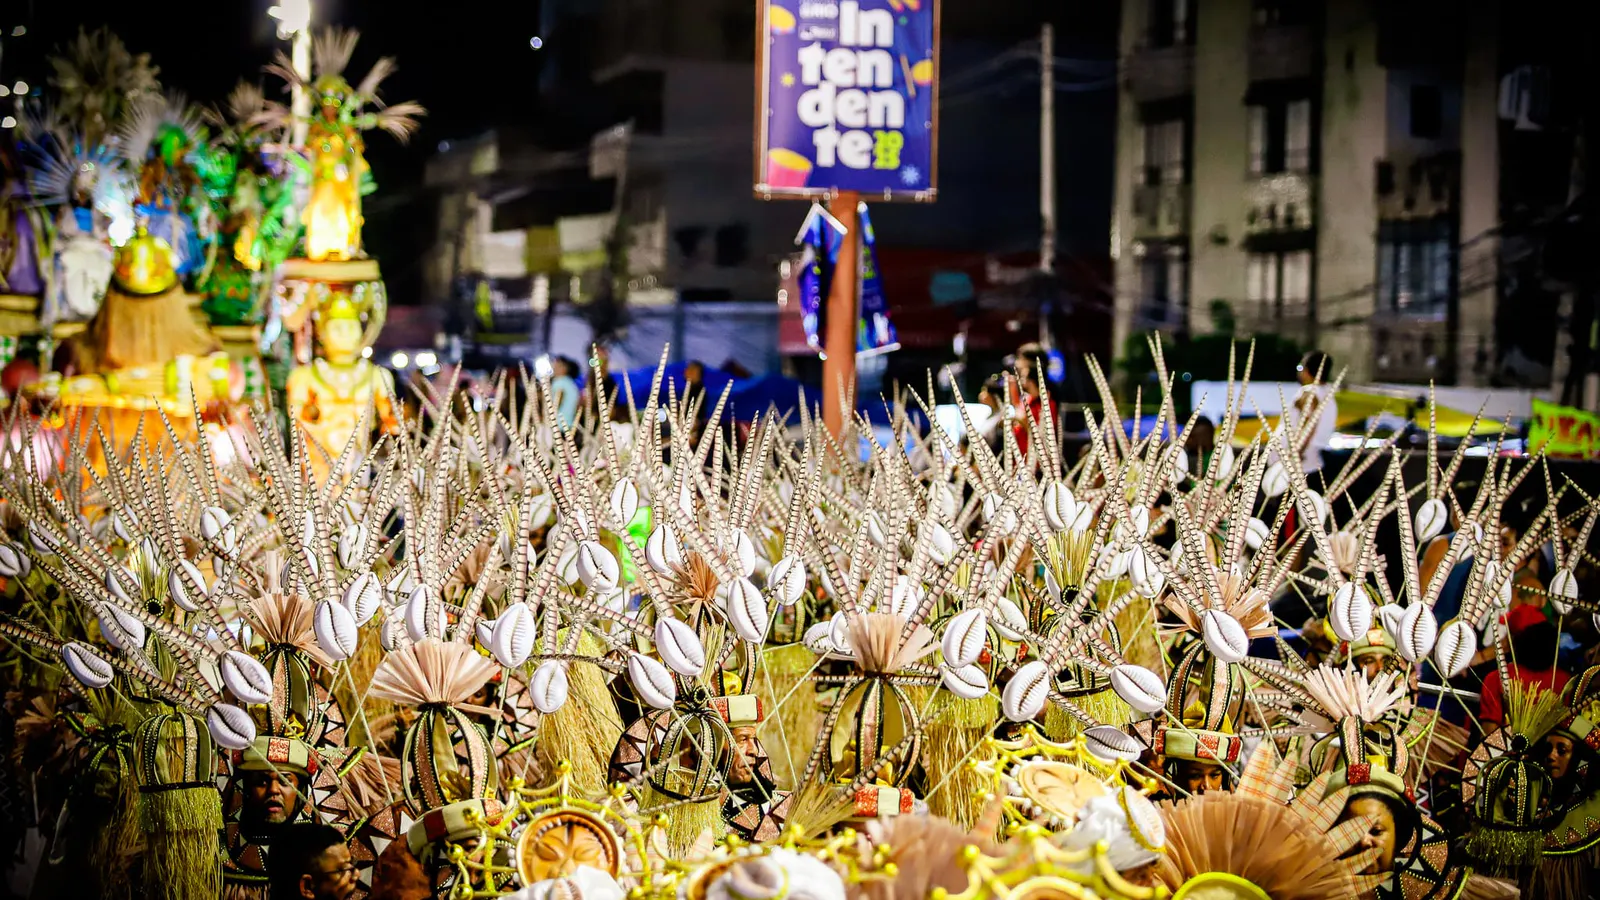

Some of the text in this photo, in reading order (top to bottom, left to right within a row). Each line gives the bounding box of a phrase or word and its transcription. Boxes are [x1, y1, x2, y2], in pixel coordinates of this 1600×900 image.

[839, 0, 894, 47] In
[798, 42, 894, 88] ten
[797, 81, 905, 128] den
[813, 127, 874, 169] te
